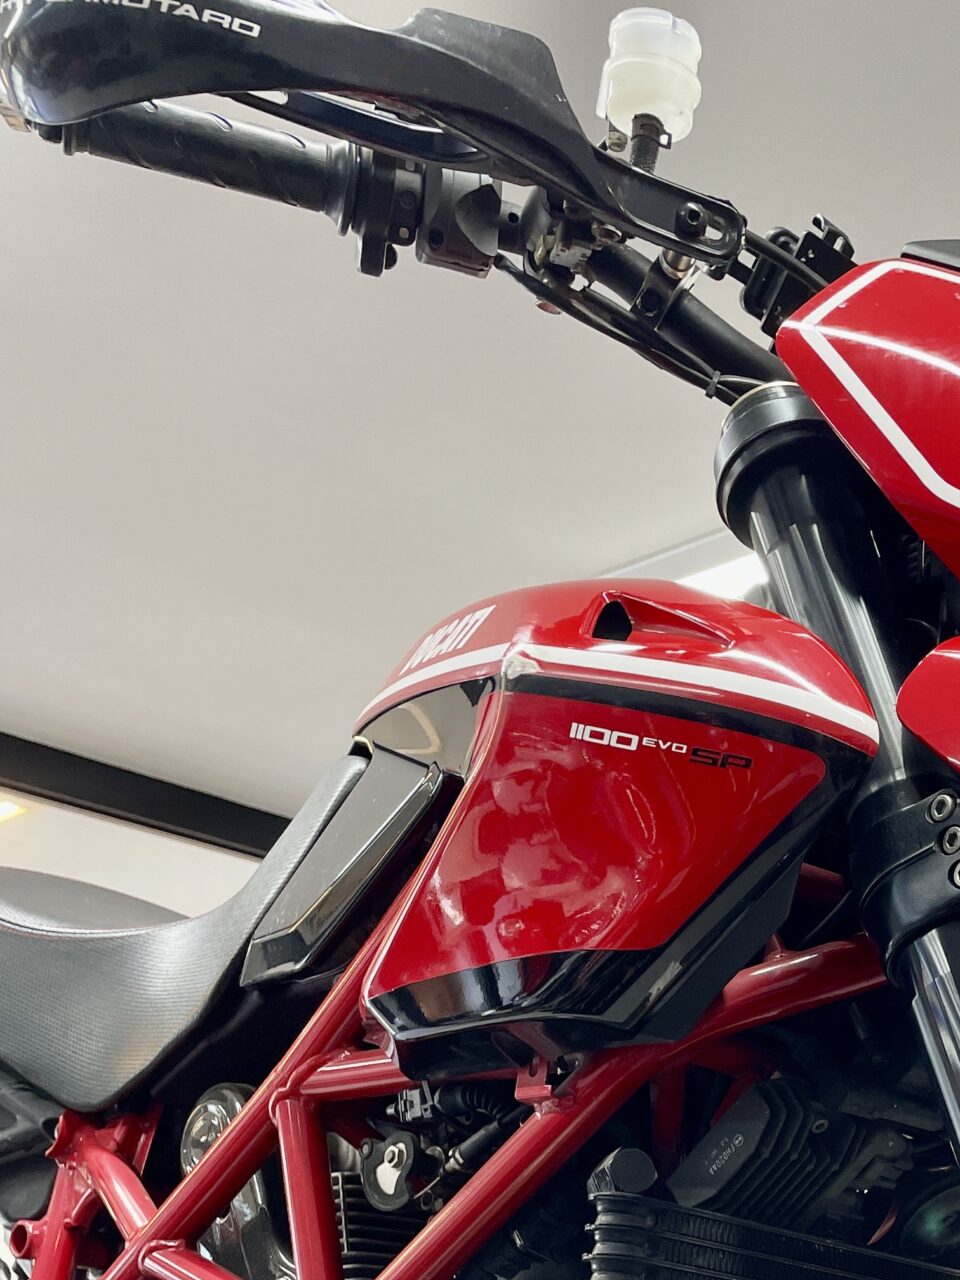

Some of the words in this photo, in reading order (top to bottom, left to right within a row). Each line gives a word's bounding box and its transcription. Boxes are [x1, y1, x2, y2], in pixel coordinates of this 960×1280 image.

[398, 604, 496, 676] DUCATI
[569, 722, 640, 751] 1100
[642, 736, 688, 753] EVO
[688, 747, 753, 769] SP
